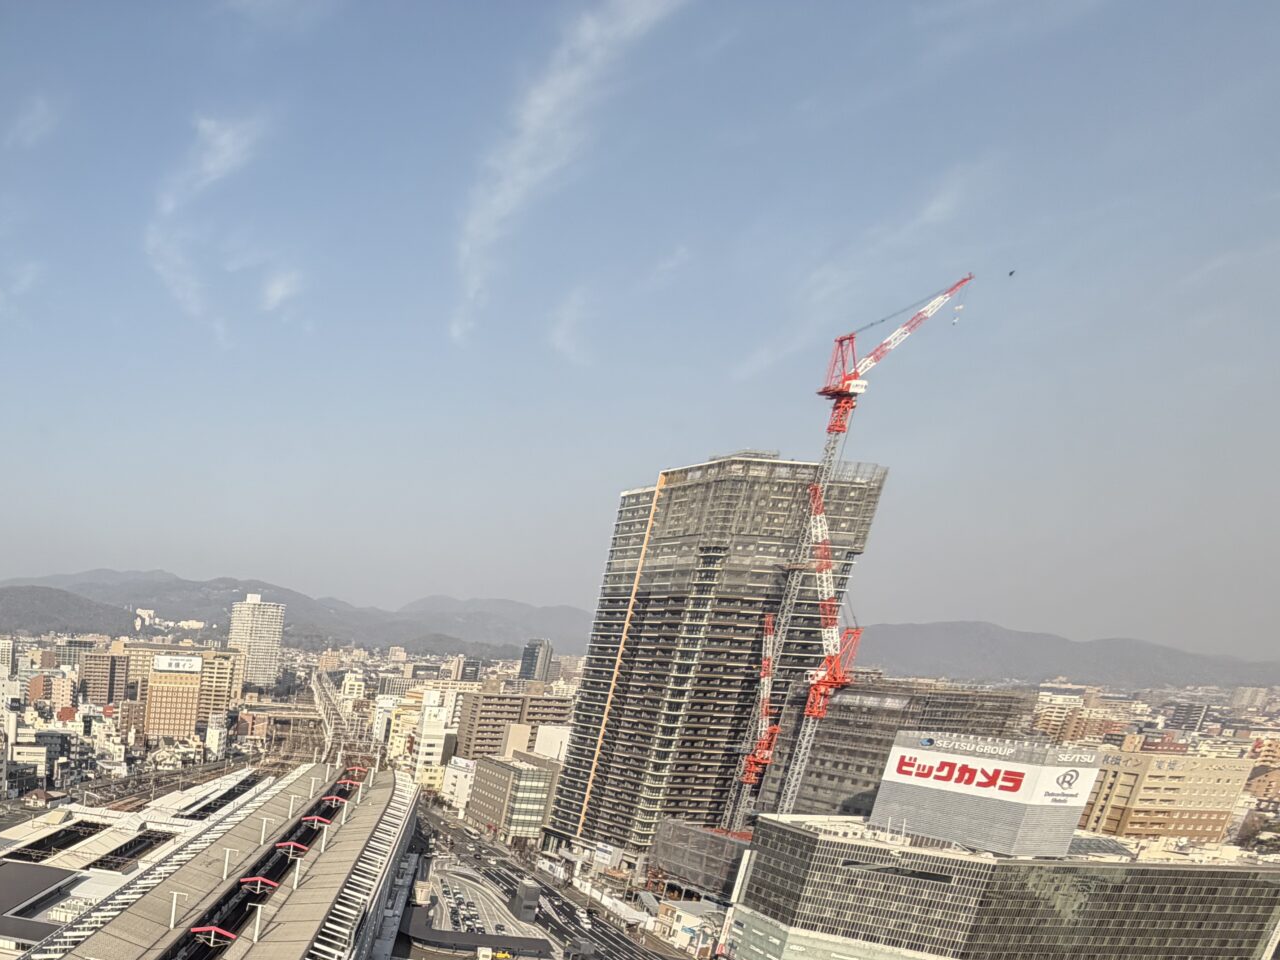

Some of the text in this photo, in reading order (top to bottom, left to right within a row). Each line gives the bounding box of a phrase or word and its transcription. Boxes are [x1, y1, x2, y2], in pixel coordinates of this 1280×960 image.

[976, 744, 1016, 756] GROUP
[896, 755, 1026, 793] ビックカメラ
